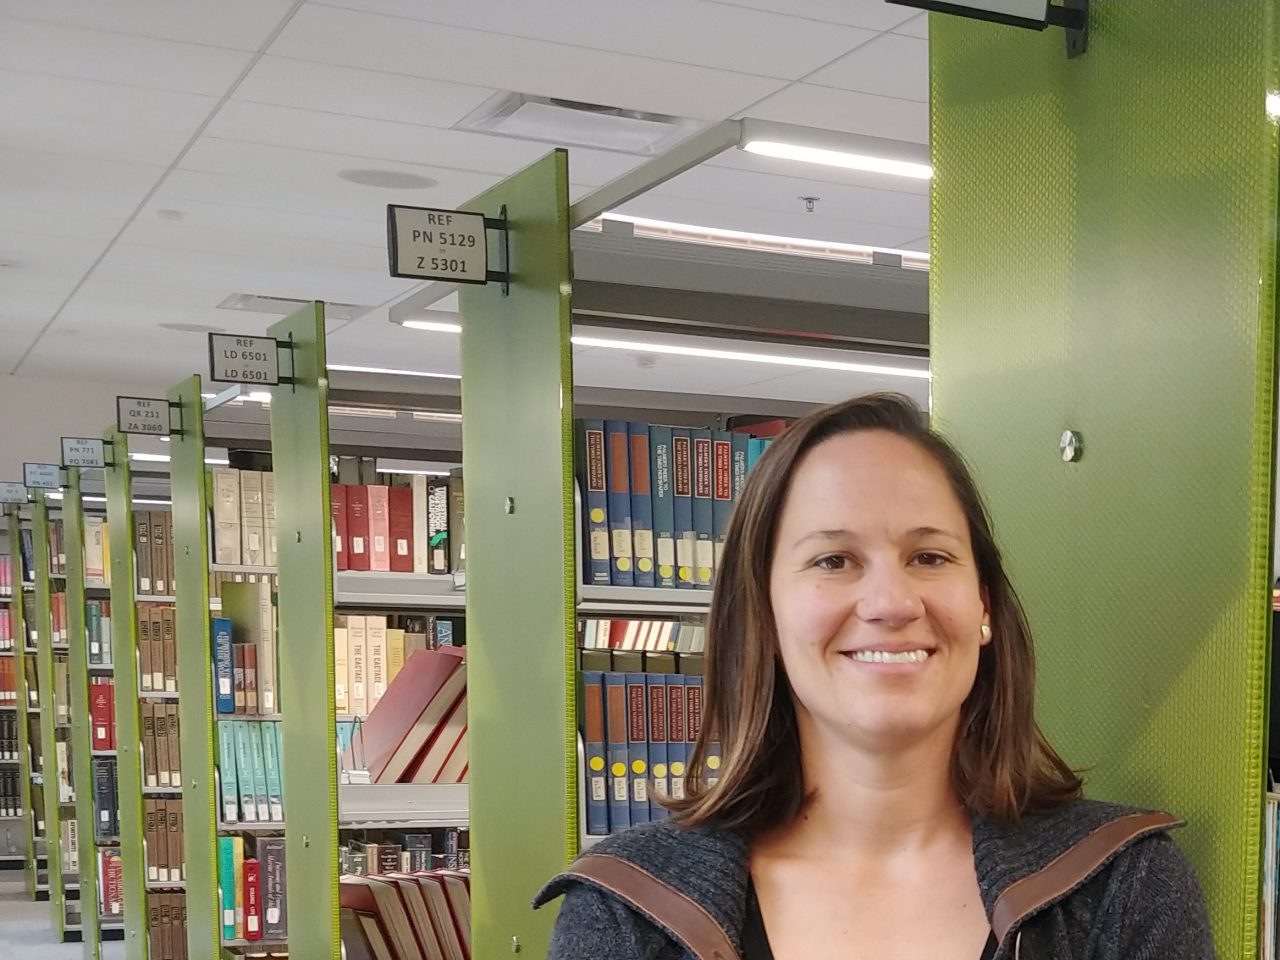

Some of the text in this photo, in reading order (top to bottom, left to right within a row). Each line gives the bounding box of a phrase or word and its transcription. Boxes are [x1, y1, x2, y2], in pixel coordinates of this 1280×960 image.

[428, 214, 452, 226] REF
[412, 230, 476, 248] PN 5129
[416, 256, 467, 272] Z 5301
[236, 339, 254, 348] REF
[224, 350, 268, 362] LD 6501
[224, 369, 268, 380] LD 6501
